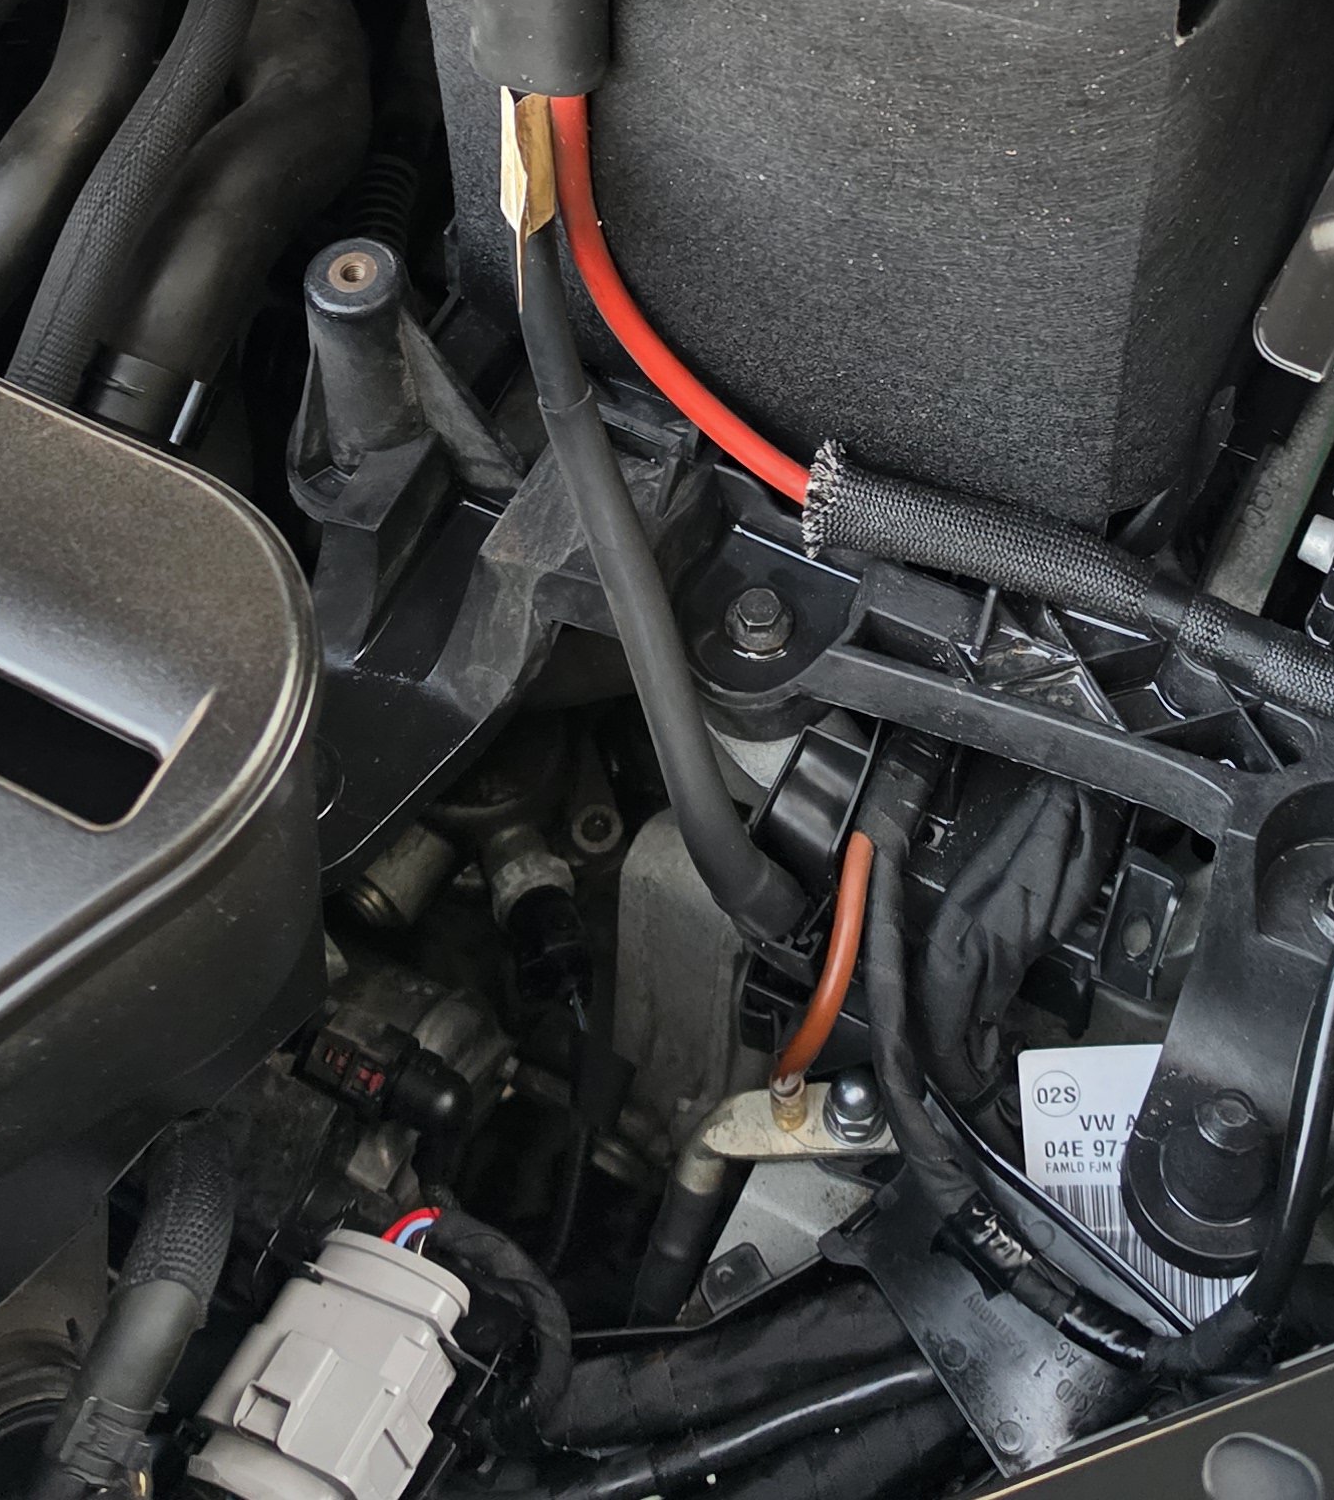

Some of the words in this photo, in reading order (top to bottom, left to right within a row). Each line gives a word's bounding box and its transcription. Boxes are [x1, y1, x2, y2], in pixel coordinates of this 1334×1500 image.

[1037, 1086, 1076, 1104] 02S
[1079, 1113, 1115, 1131] VW
[1044, 1140, 1083, 1158] 04E
[1045, 1161, 1085, 1173] FAMLD
[1089, 1161, 1112, 1173] FJM
[1055, 1341, 1083, 1368] AG
